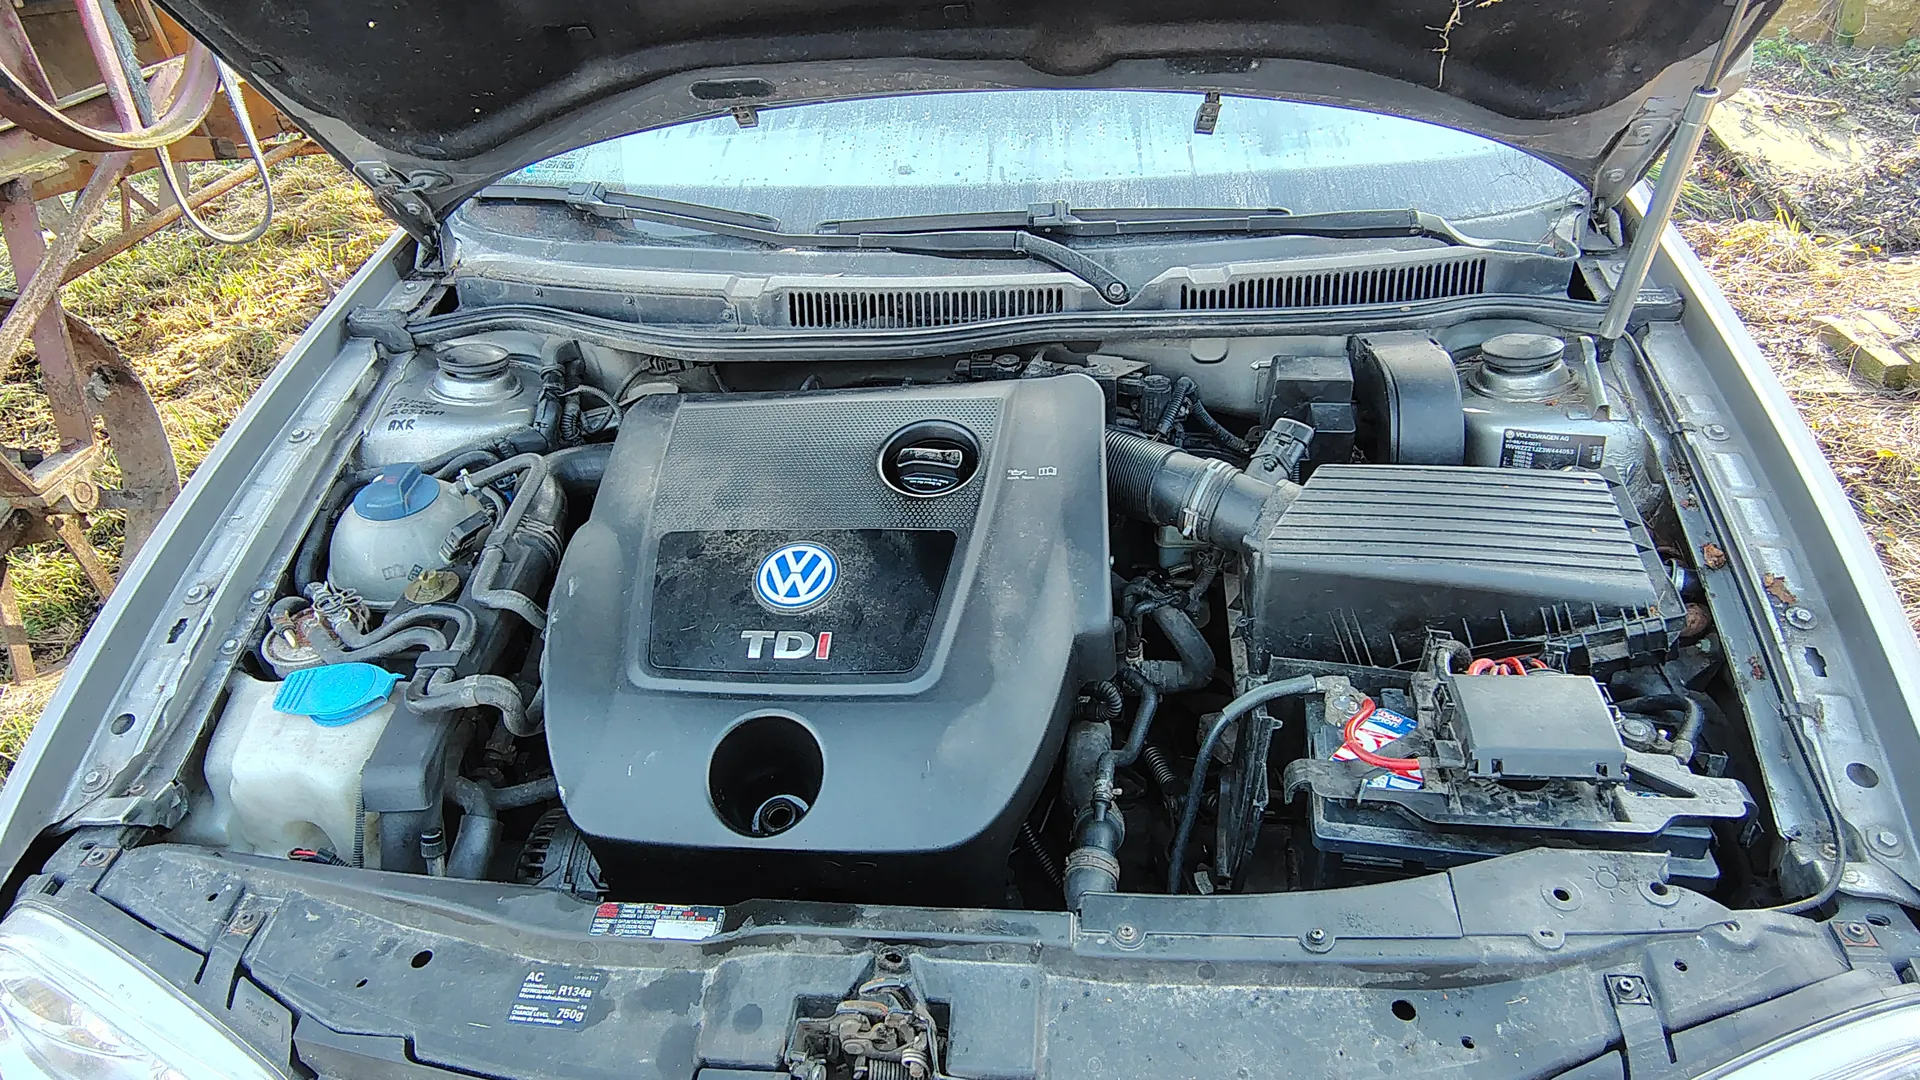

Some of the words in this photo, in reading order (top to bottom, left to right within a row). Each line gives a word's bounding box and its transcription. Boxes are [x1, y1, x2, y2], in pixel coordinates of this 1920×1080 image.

[388, 419, 416, 432] AXR
[1515, 432, 1560, 441] VOLKSWAGEN
[756, 543, 838, 608] VW
[740, 630, 833, 660] TDI
[525, 971, 544, 982] AC
[557, 985, 592, 998] R134a
[556, 1008, 584, 1022] 750g
